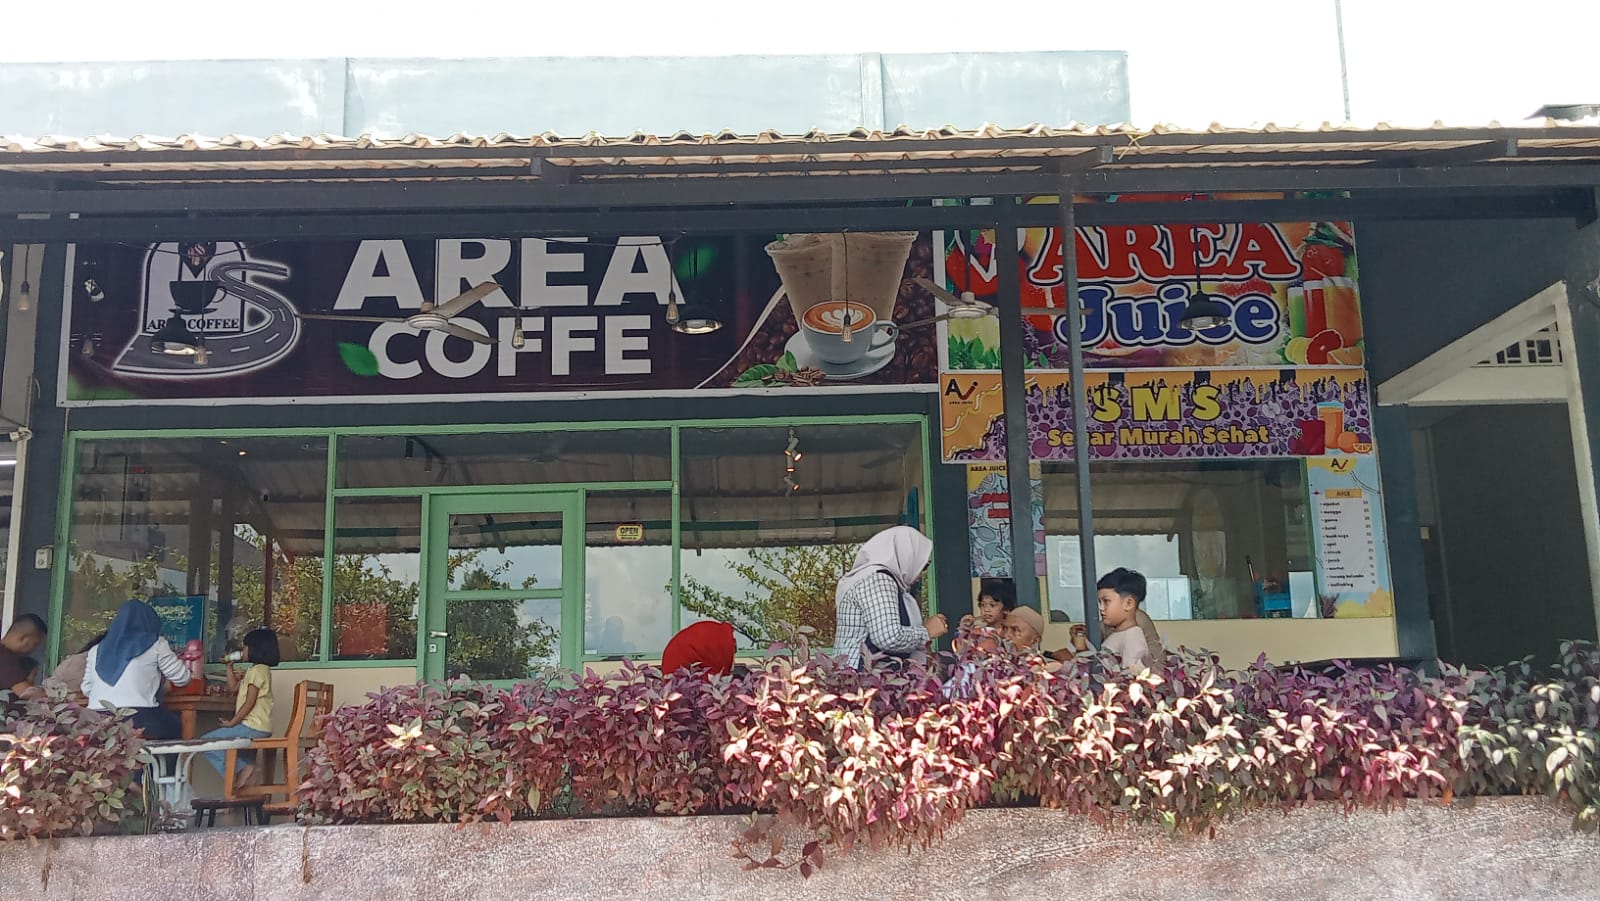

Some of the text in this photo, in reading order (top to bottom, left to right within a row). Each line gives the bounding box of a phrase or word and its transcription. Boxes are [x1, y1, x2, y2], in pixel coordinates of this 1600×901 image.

[333, 236, 686, 310] AREA
[1028, 222, 1303, 285] AREA
[188, 318, 240, 330] COFFEE
[368, 314, 652, 380] COFFE
[1047, 425, 1270, 447] Sear Murah Sehat
